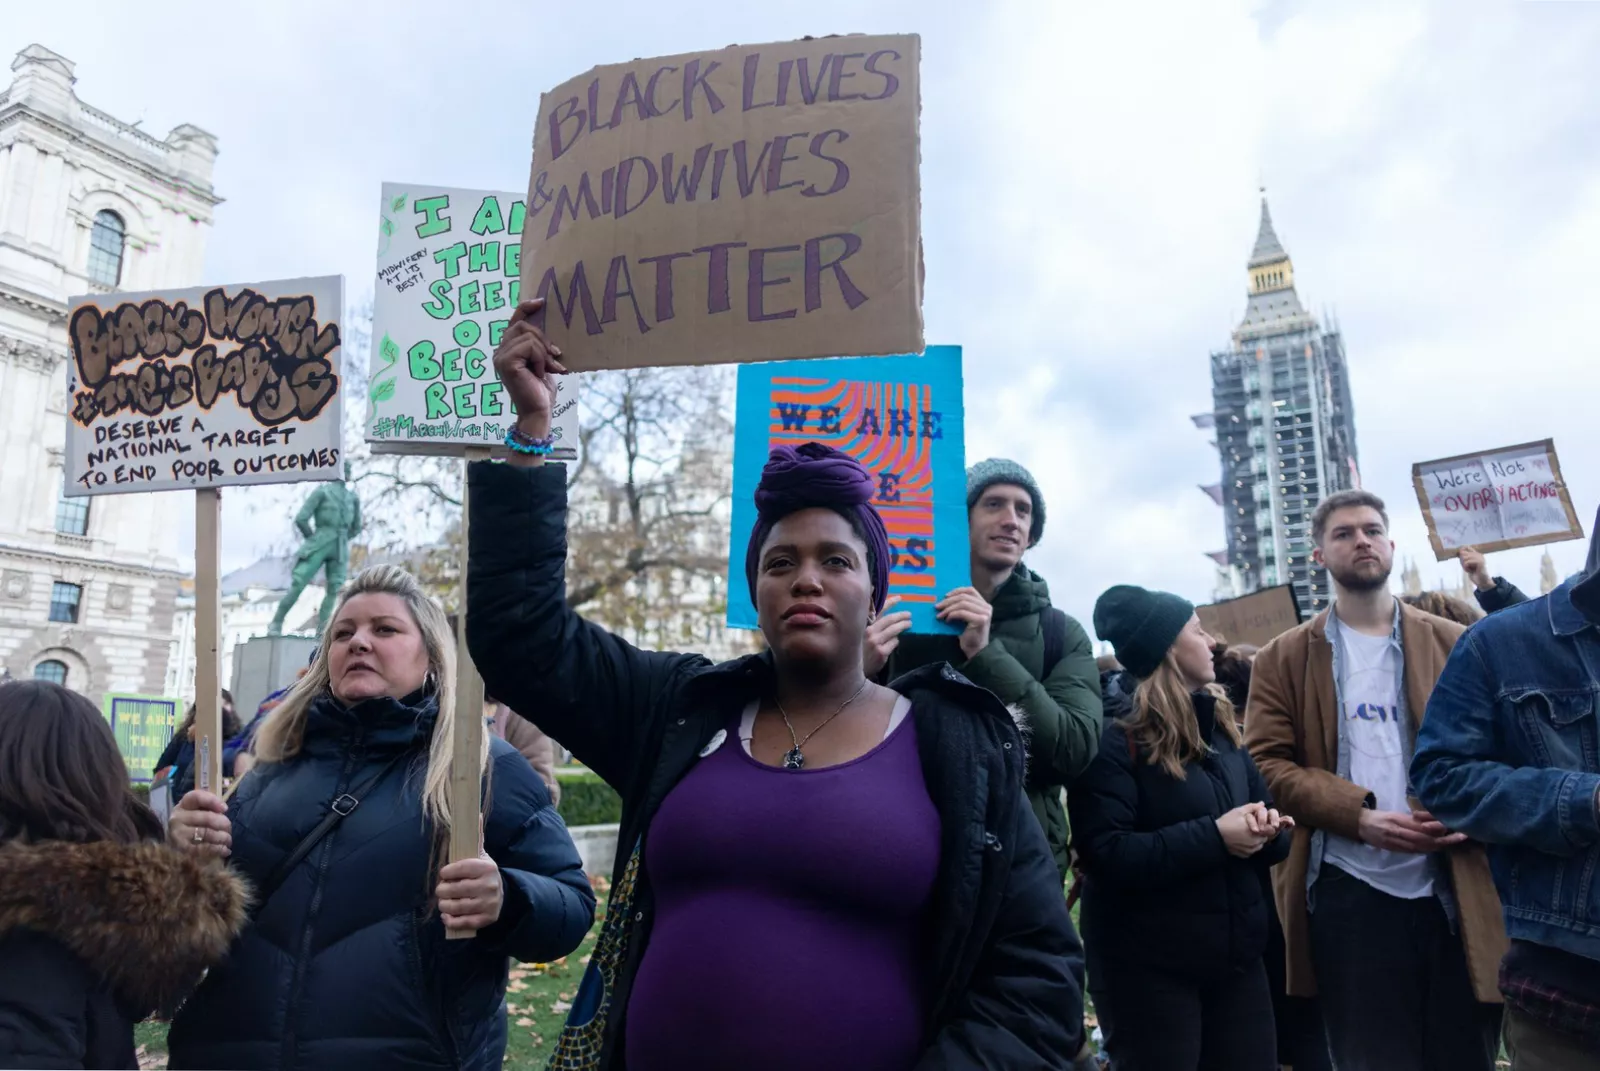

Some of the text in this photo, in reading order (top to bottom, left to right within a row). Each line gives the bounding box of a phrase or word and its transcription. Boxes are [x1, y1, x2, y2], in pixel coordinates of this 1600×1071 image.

[548, 49, 902, 161] BLACK LIVES
[529, 129, 850, 240] & MIDWIVES
[414, 195, 452, 239] I
[378, 247, 427, 280] MIDWIFERY
[386, 263, 420, 286] AT ITS
[433, 241, 521, 279] THE
[395, 271, 426, 293] BEST!
[533, 232, 870, 336] MATTER
[407, 340, 501, 381] BEC
[95, 416, 205, 444] DESERVE A
[776, 402, 943, 440] WE ARE
[88, 427, 296, 466] NATIONAL TARGET
[77, 448, 340, 489] TO END POOR OUTCOMES
[1491, 461, 1525, 478] Not
[119, 712, 140, 726] WE
